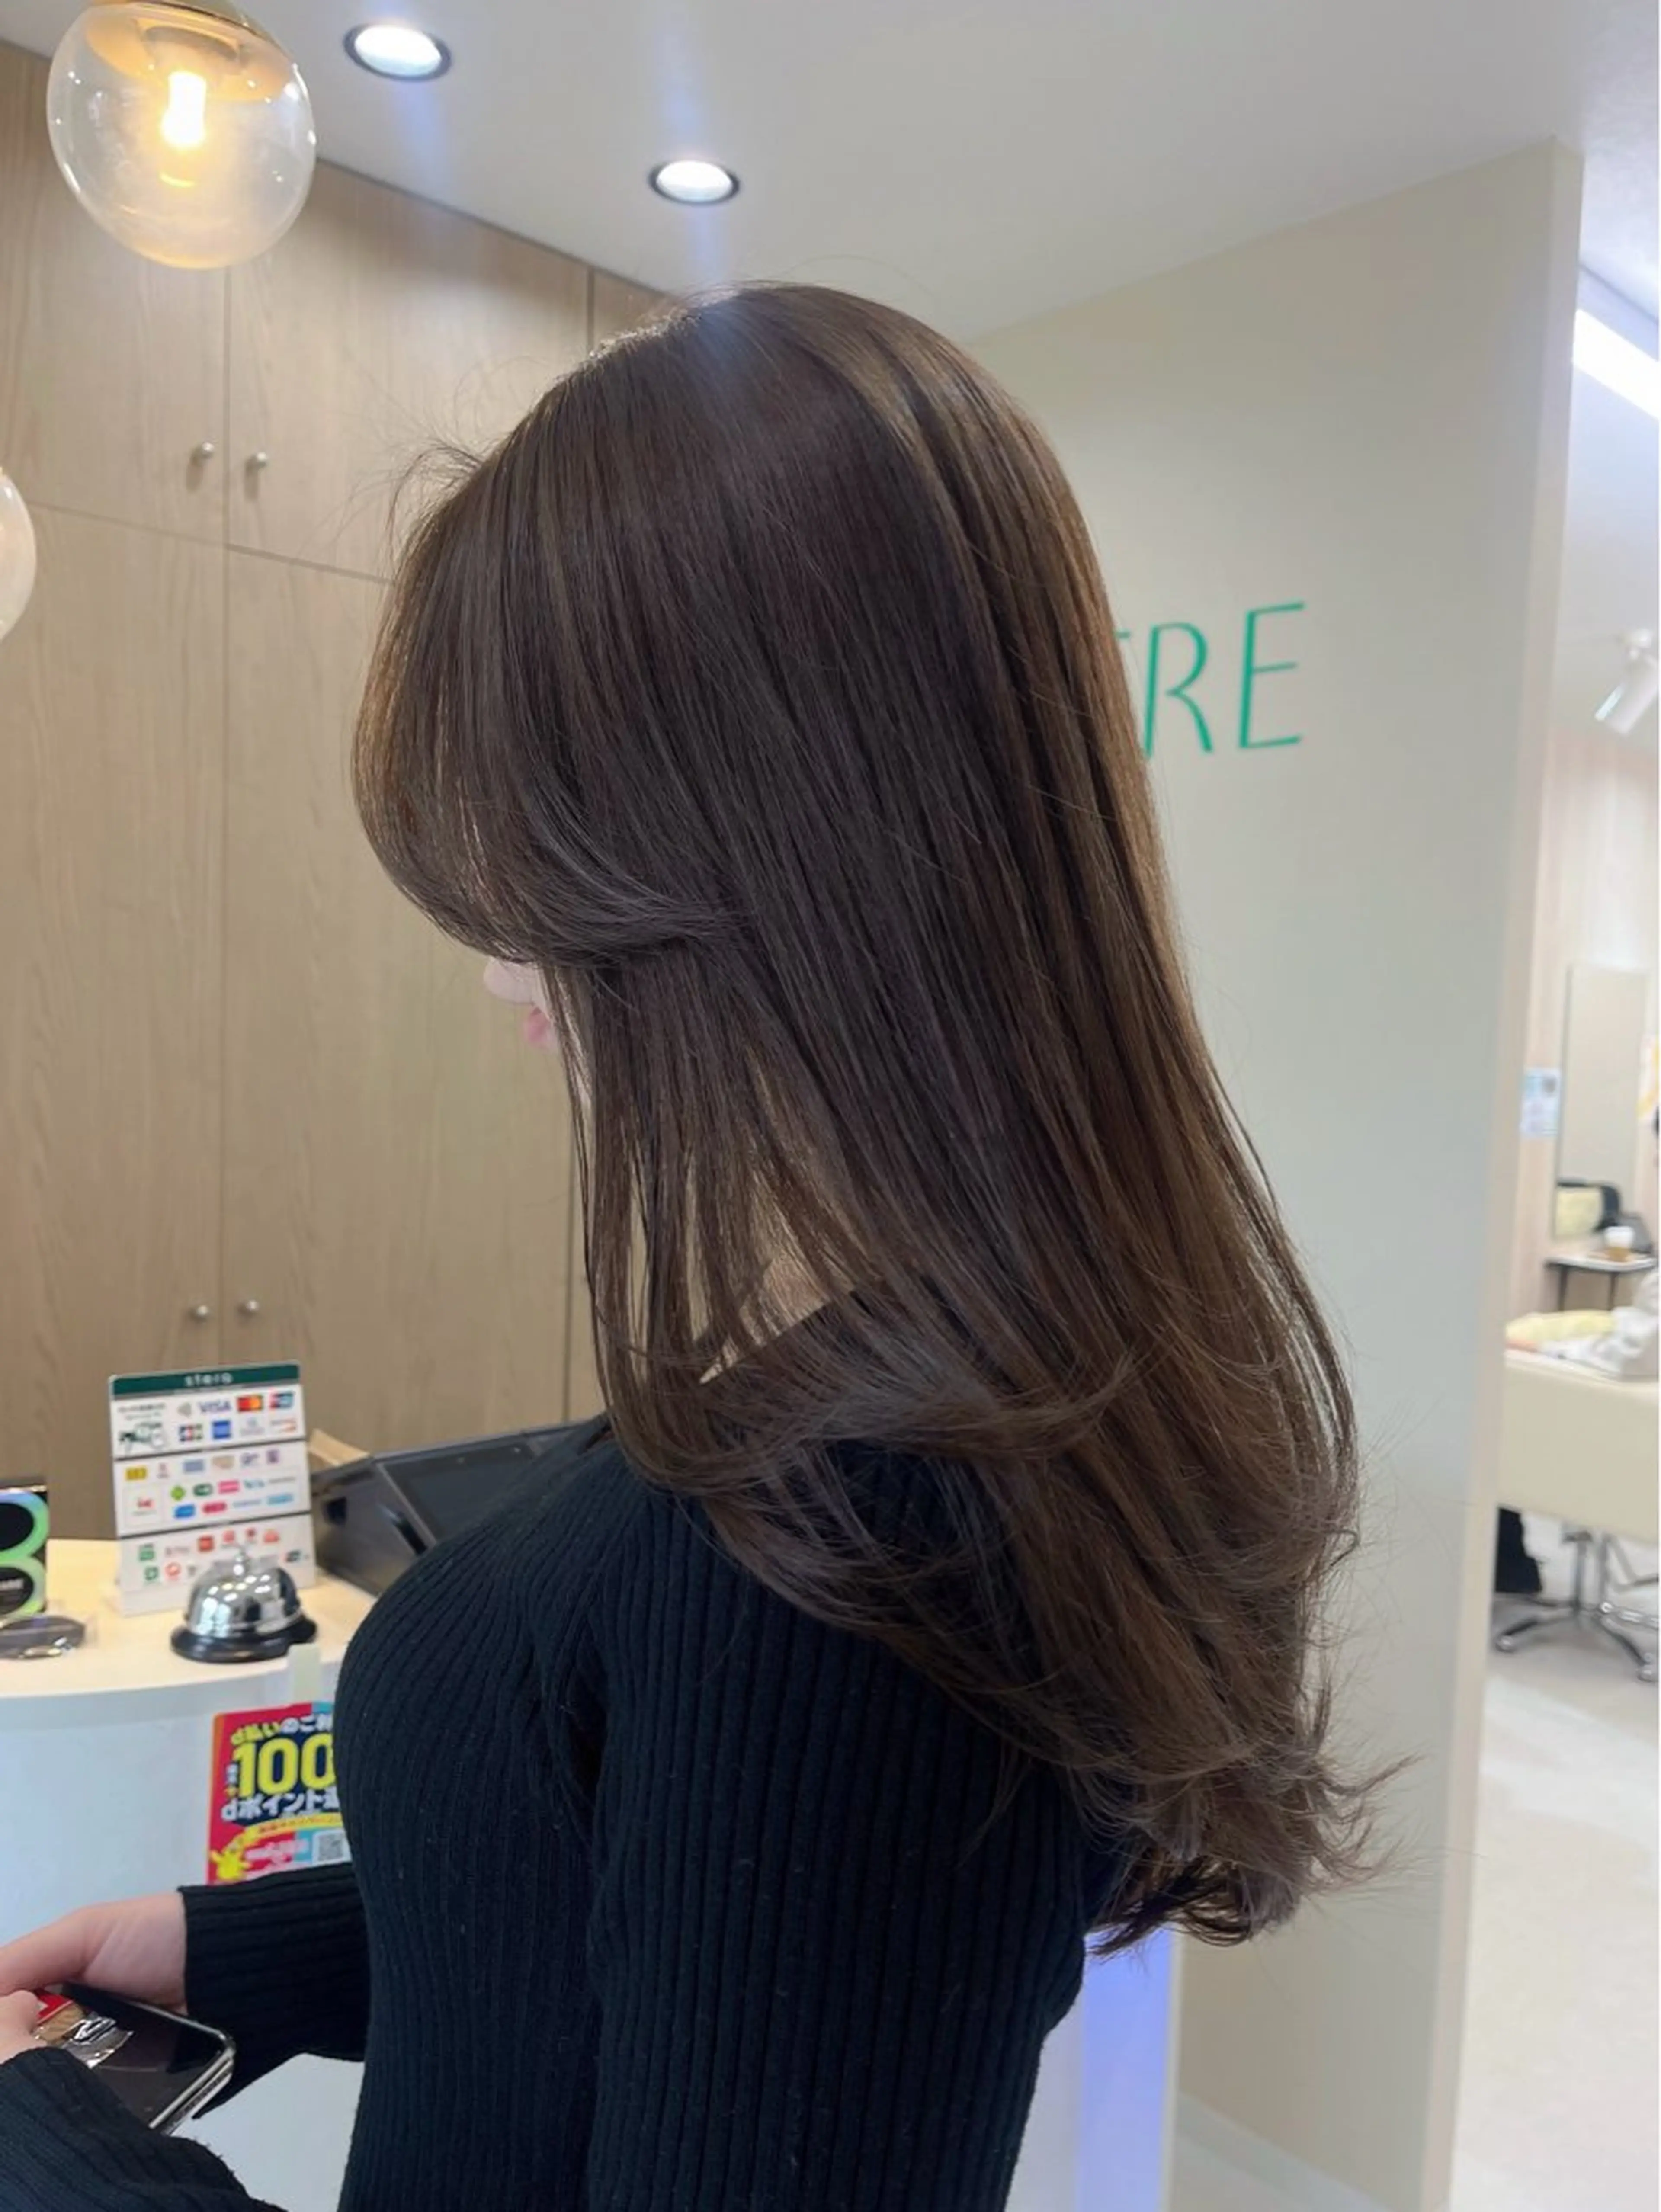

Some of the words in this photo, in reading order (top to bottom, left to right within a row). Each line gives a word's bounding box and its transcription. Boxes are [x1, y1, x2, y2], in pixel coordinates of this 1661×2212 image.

[1114, 602, 1305, 760] RE
[198, 1401, 232, 1414] VISA
[232, 1733, 337, 1798] 100
